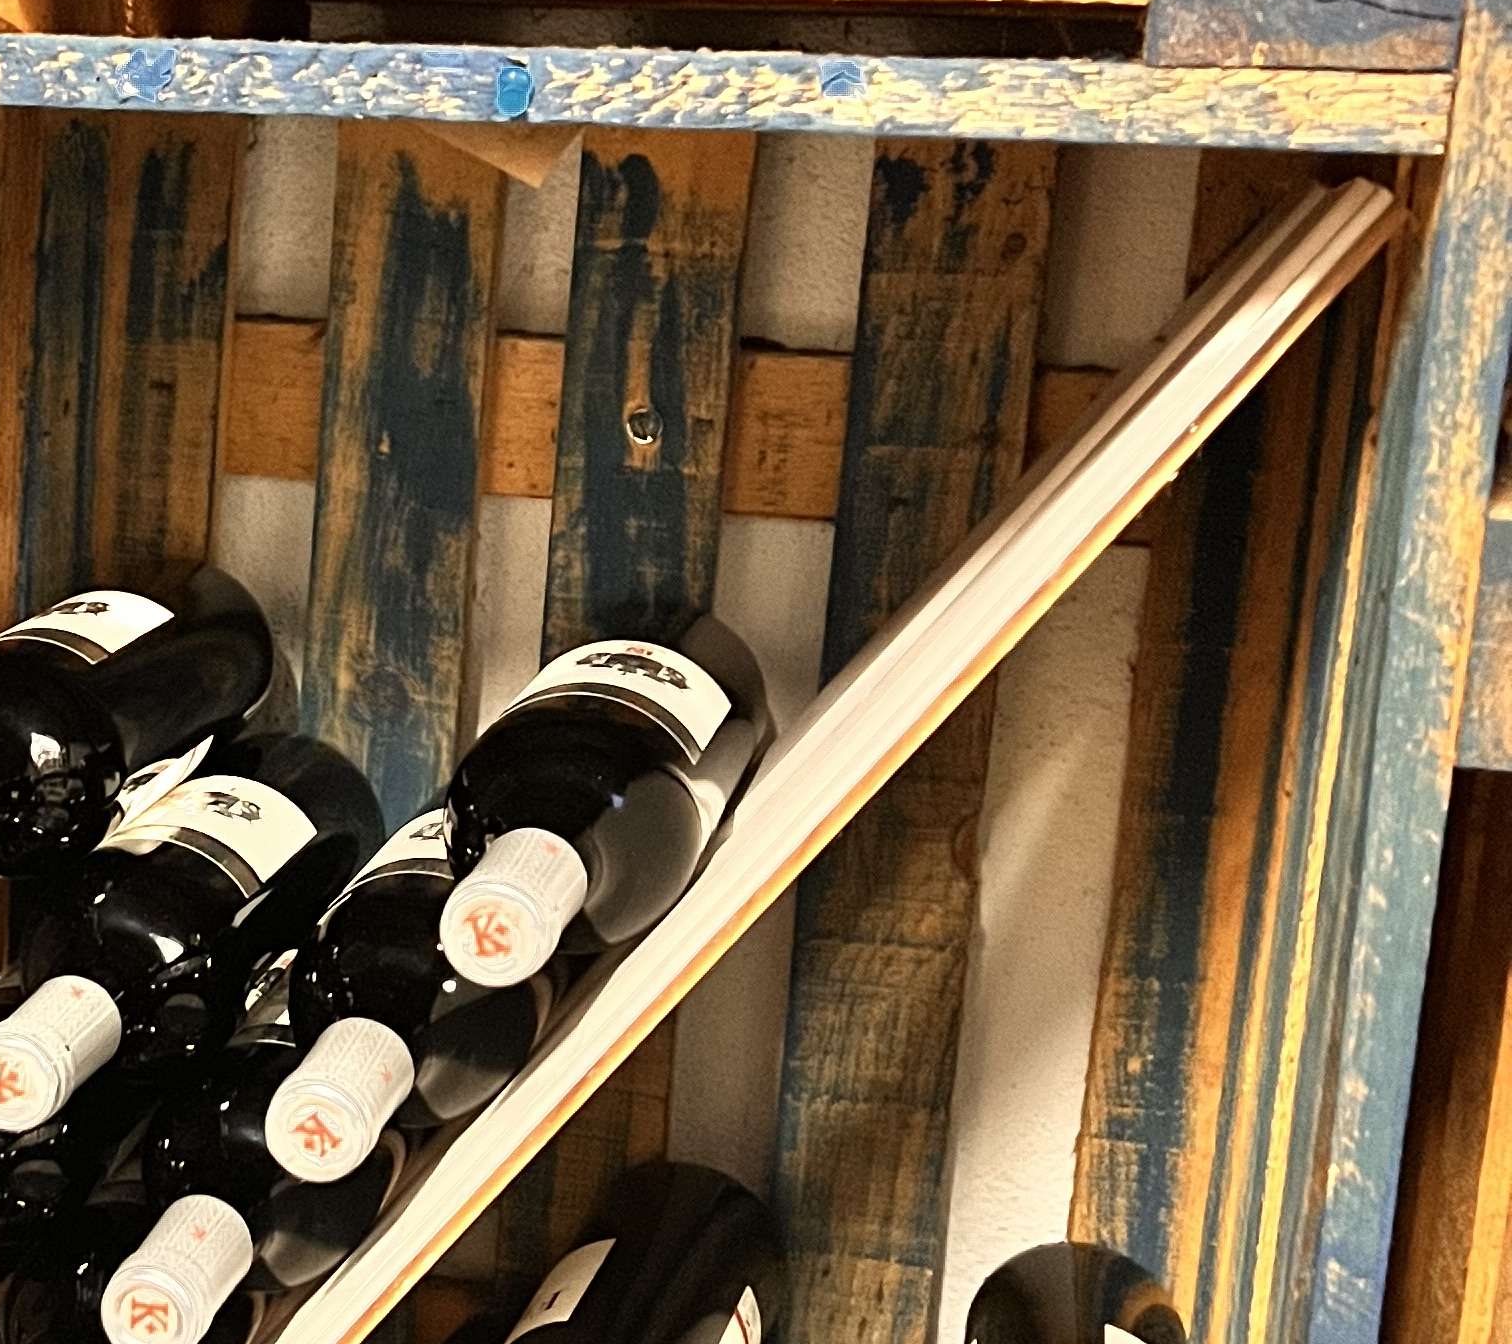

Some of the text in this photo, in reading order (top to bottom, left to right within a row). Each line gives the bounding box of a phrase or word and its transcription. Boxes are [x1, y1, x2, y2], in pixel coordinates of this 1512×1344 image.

[464, 913, 510, 956] K
[293, 1113, 342, 1157] K
[131, 1297, 168, 1333] K
